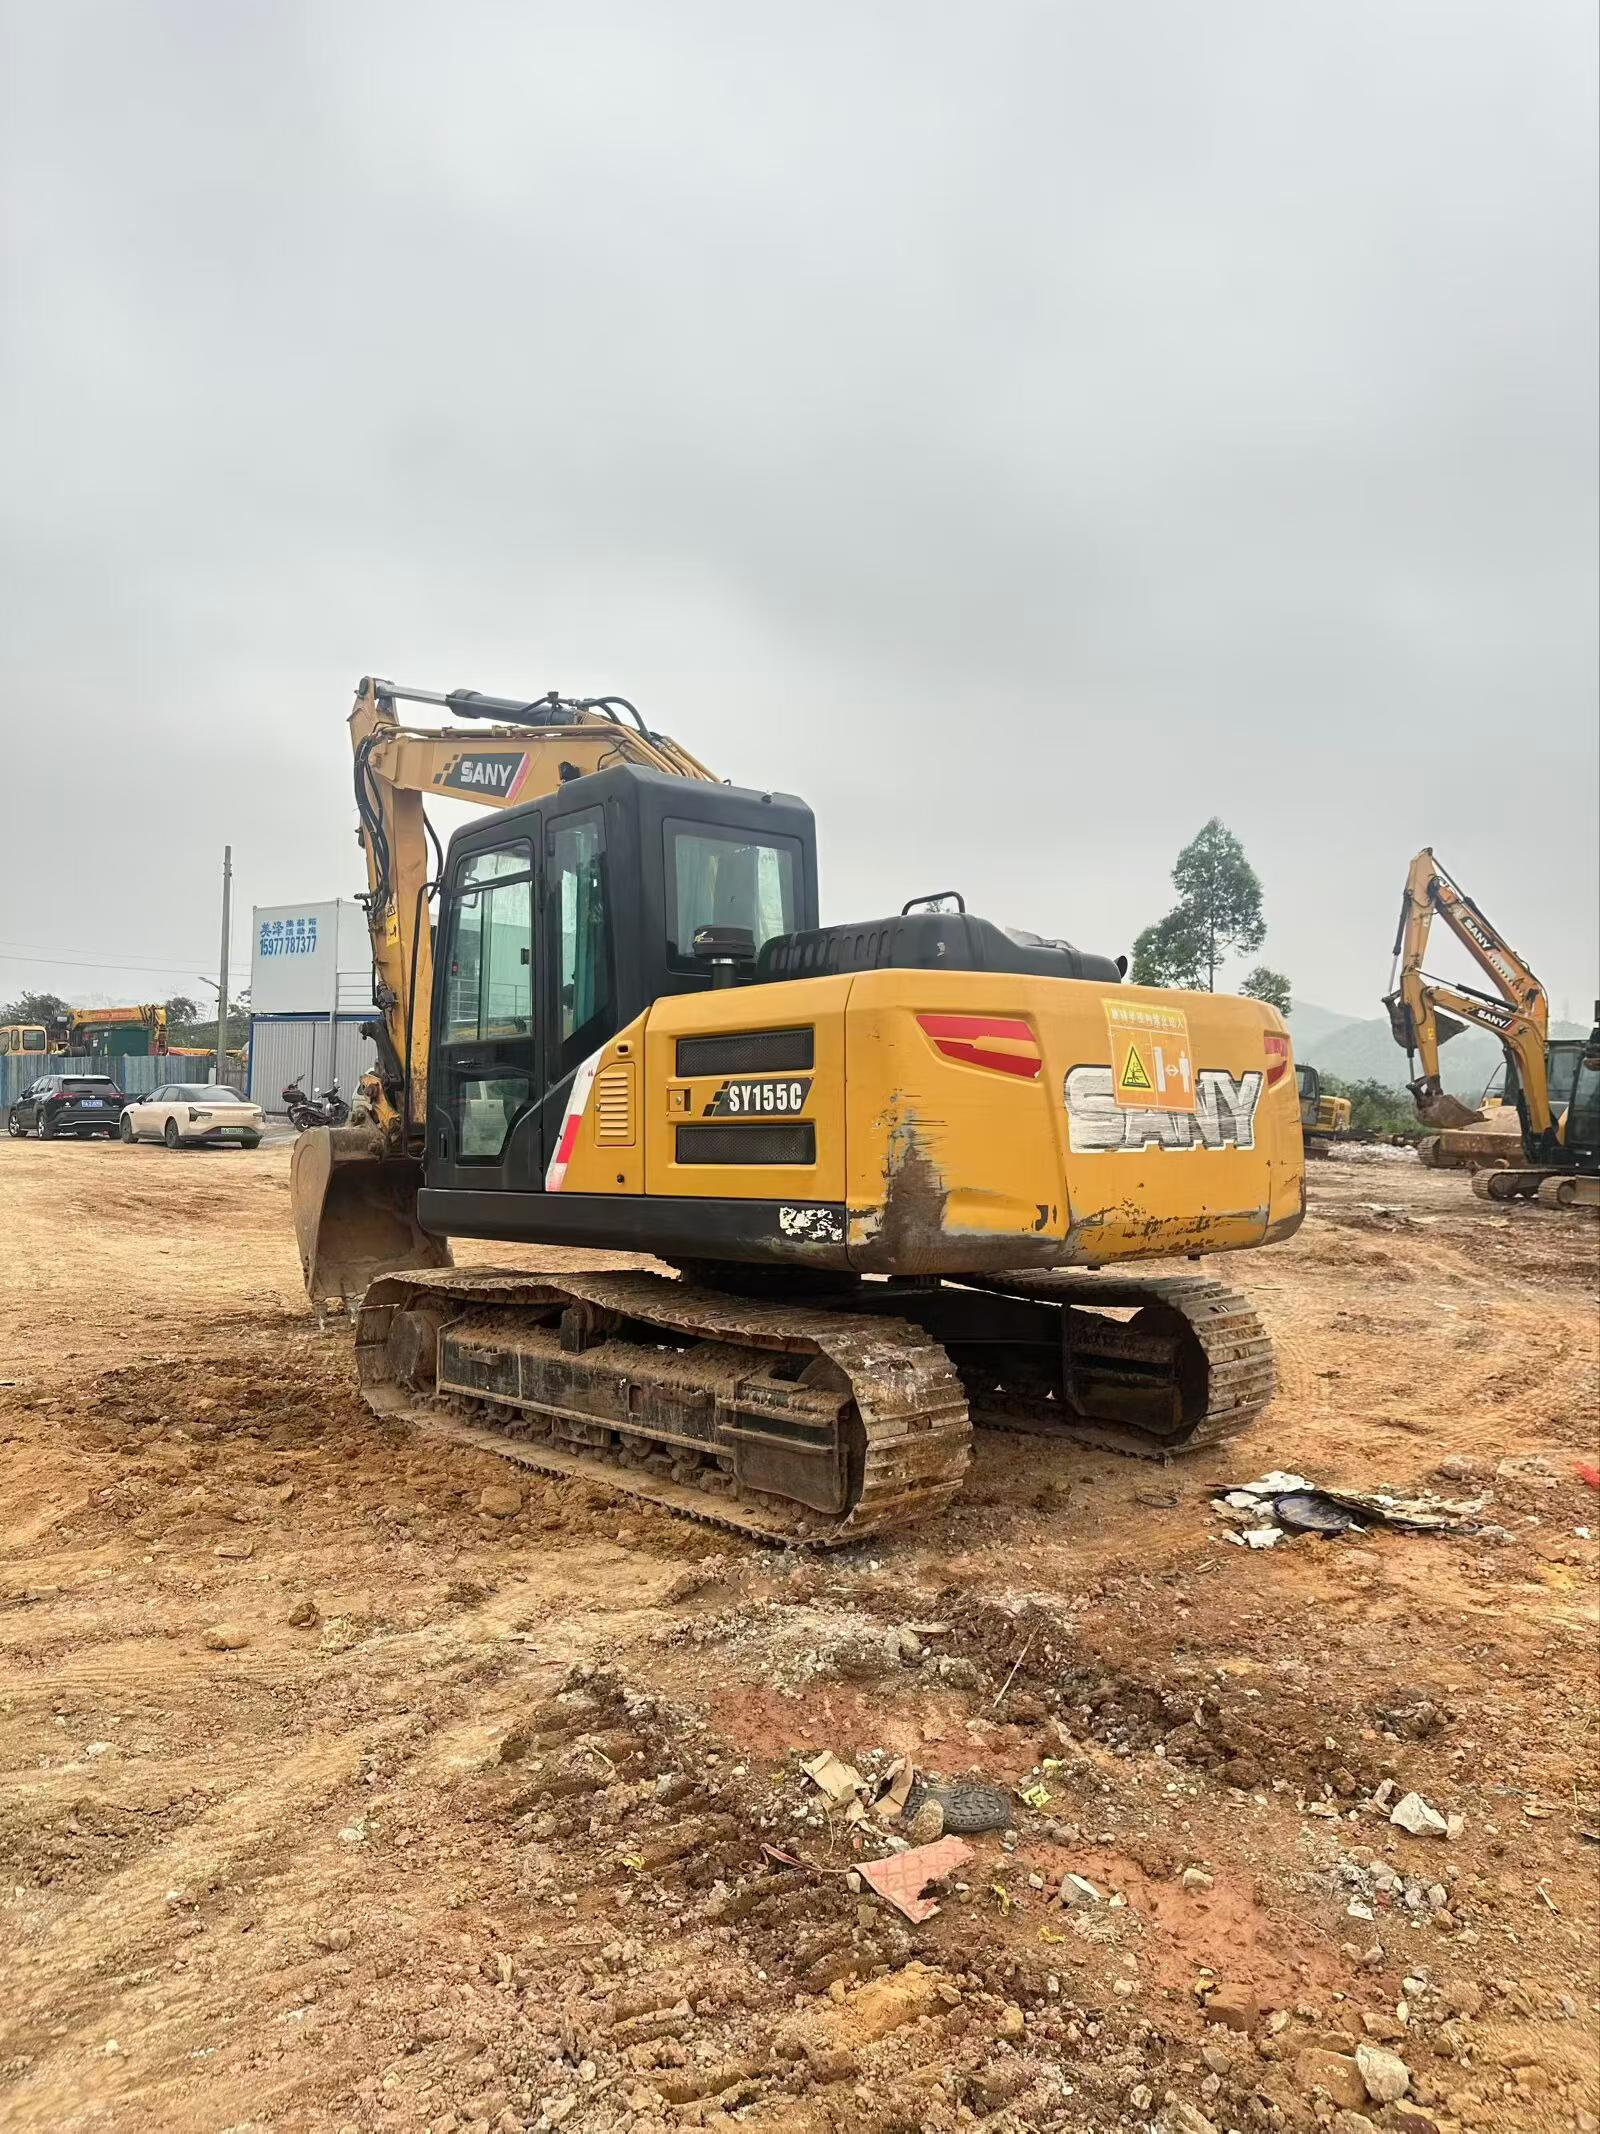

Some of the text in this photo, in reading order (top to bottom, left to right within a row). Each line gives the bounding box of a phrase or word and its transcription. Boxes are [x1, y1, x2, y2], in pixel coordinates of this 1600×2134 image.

[460, 761, 513, 788] SANY
[1464, 918, 1492, 949] SANY
[1477, 1009, 1508, 1029] SANY
[729, 1082, 802, 1112] SY155C
